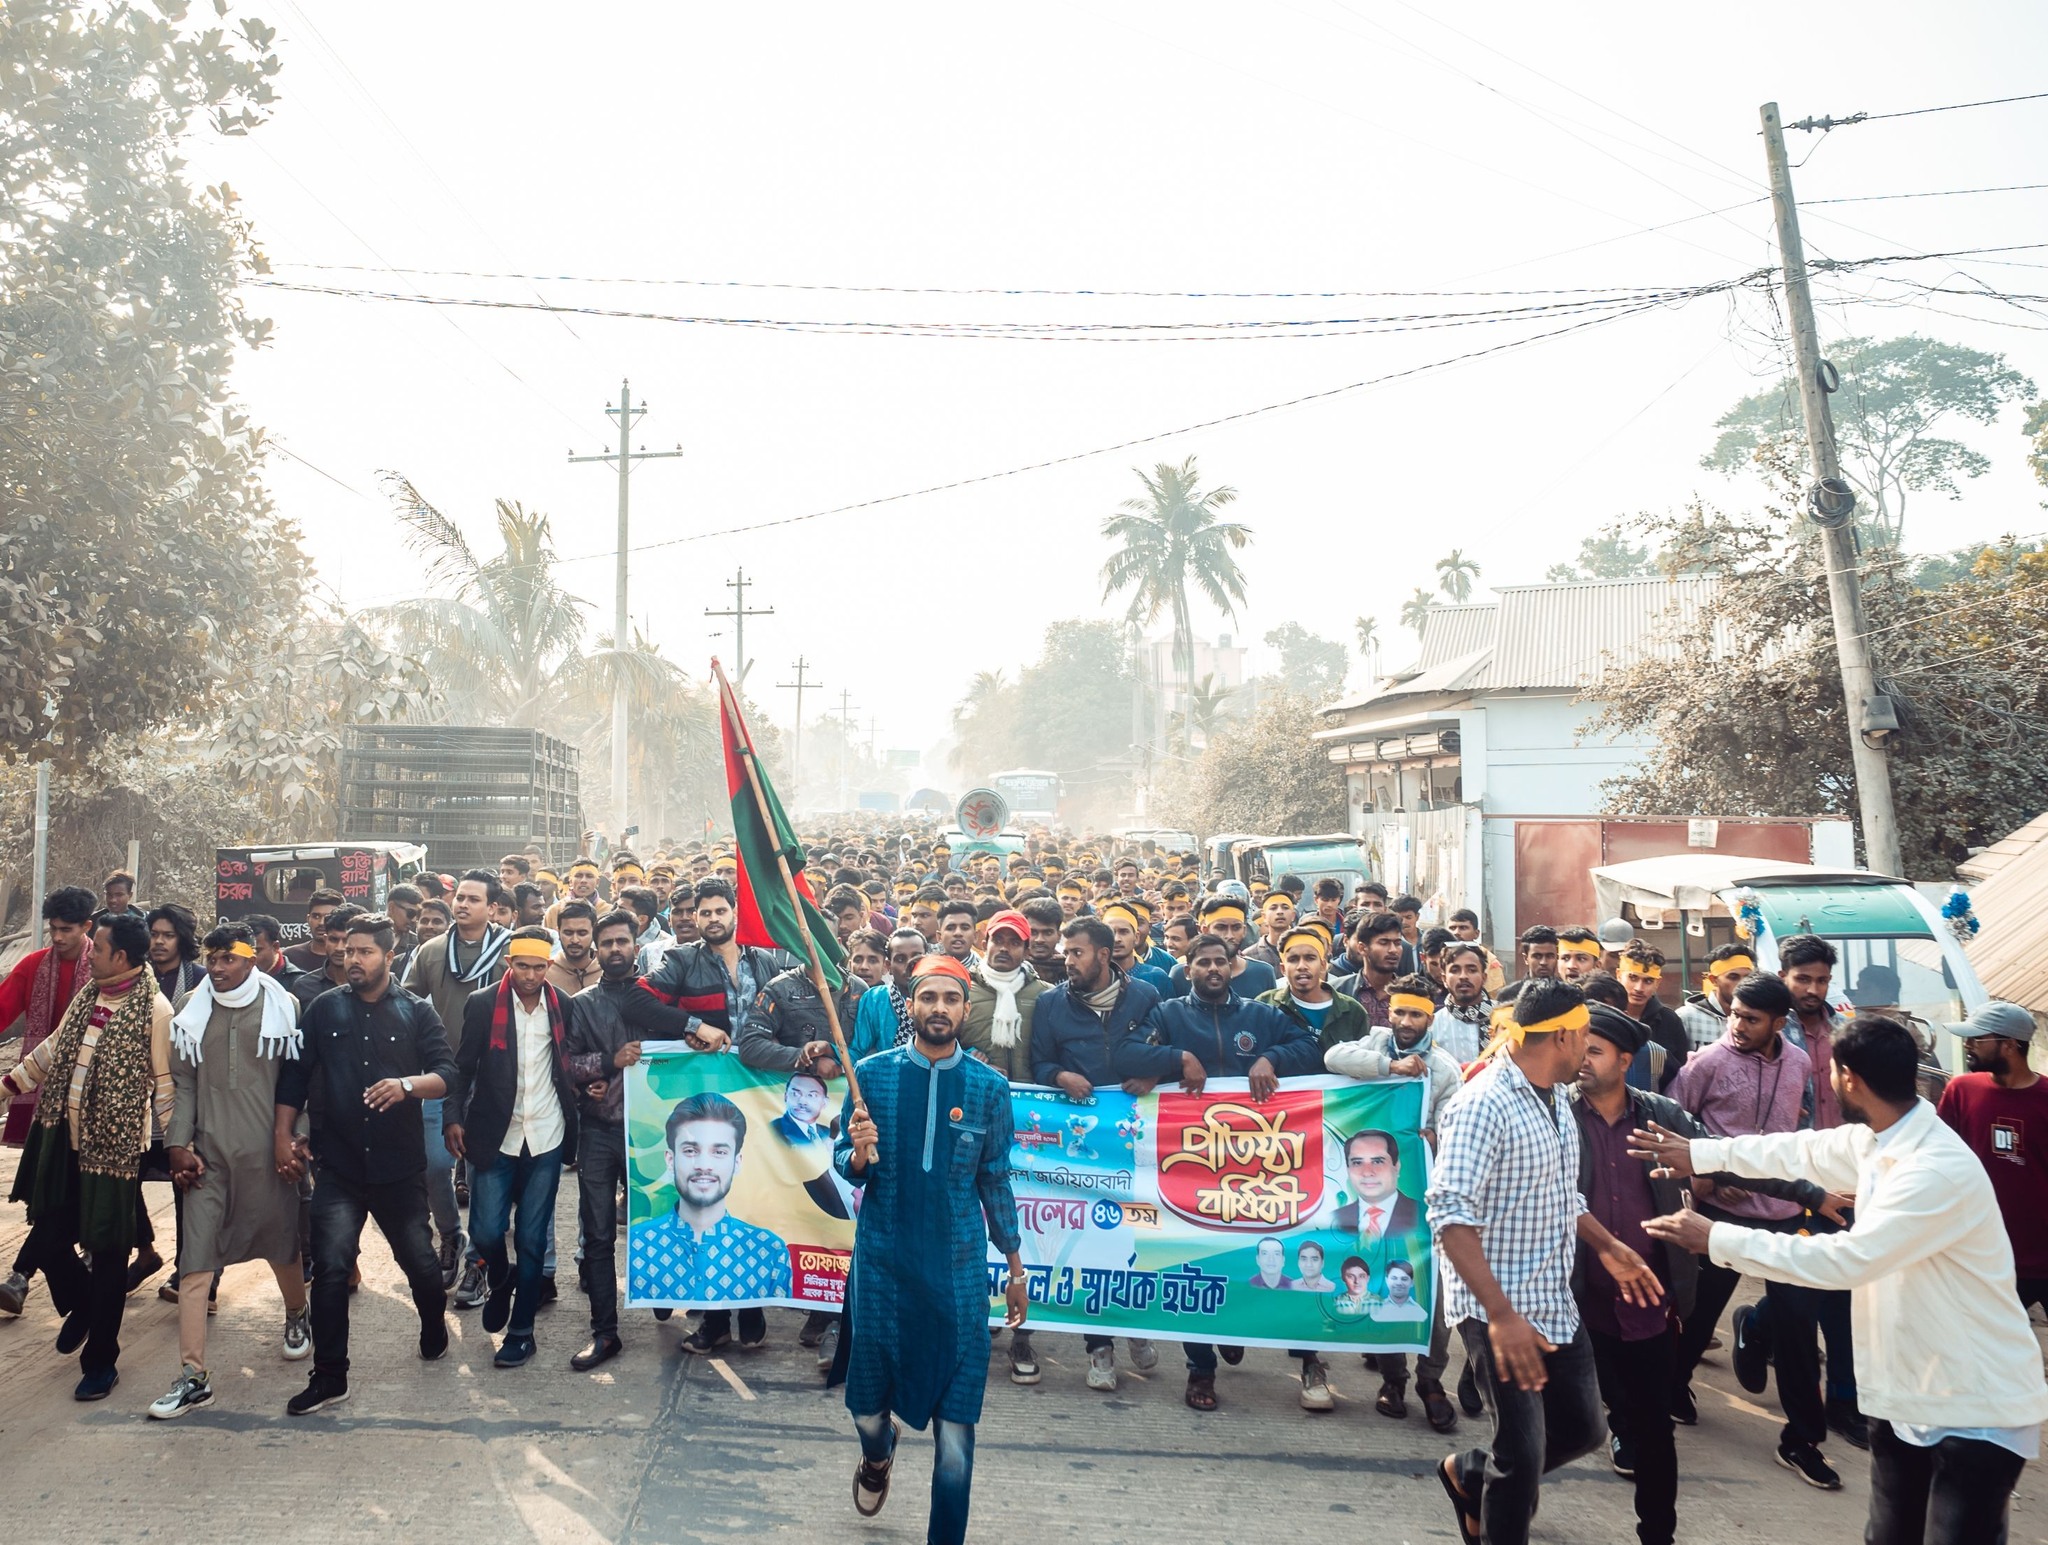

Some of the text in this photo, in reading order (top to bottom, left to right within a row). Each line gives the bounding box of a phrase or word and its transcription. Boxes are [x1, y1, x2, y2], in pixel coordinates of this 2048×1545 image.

[343, 884, 370, 898] লাম
[1161, 1102, 1306, 1175] প্রতিষ্ঠা
[1033, 1166, 1133, 1191] জাতীয়তাবাদী
[1196, 1170, 1308, 1225] বার্ষিকী
[1014, 1197, 1089, 1235] দলের
[1125, 1206, 1158, 1226] তম
[1056, 1265, 1075, 1307] ও
[1080, 1252, 1159, 1316] স্বার্থক
[1161, 1261, 1229, 1316] হউক
